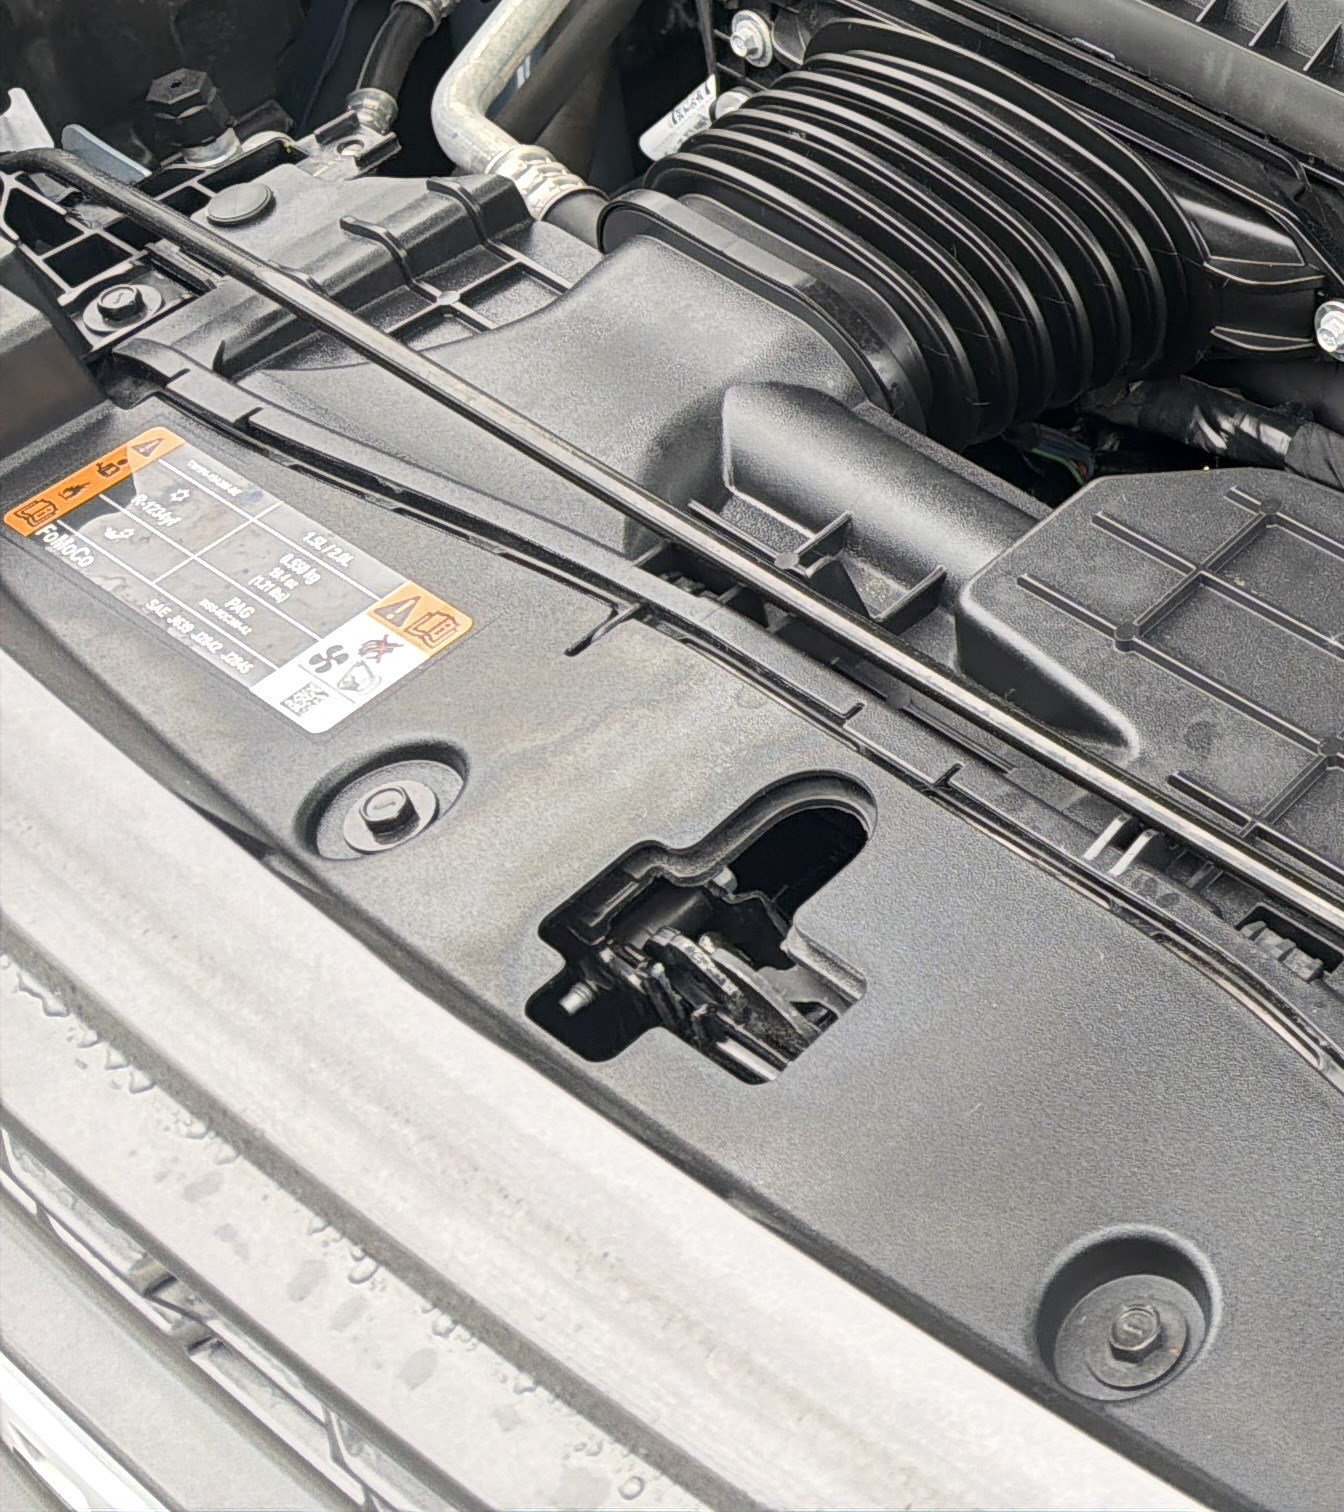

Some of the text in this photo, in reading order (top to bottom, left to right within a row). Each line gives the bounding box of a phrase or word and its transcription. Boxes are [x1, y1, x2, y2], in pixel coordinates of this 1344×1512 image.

[125, 493, 182, 530] R-1234yf
[33, 523, 100, 568] FoMoCo
[222, 596, 257, 619] PAG
